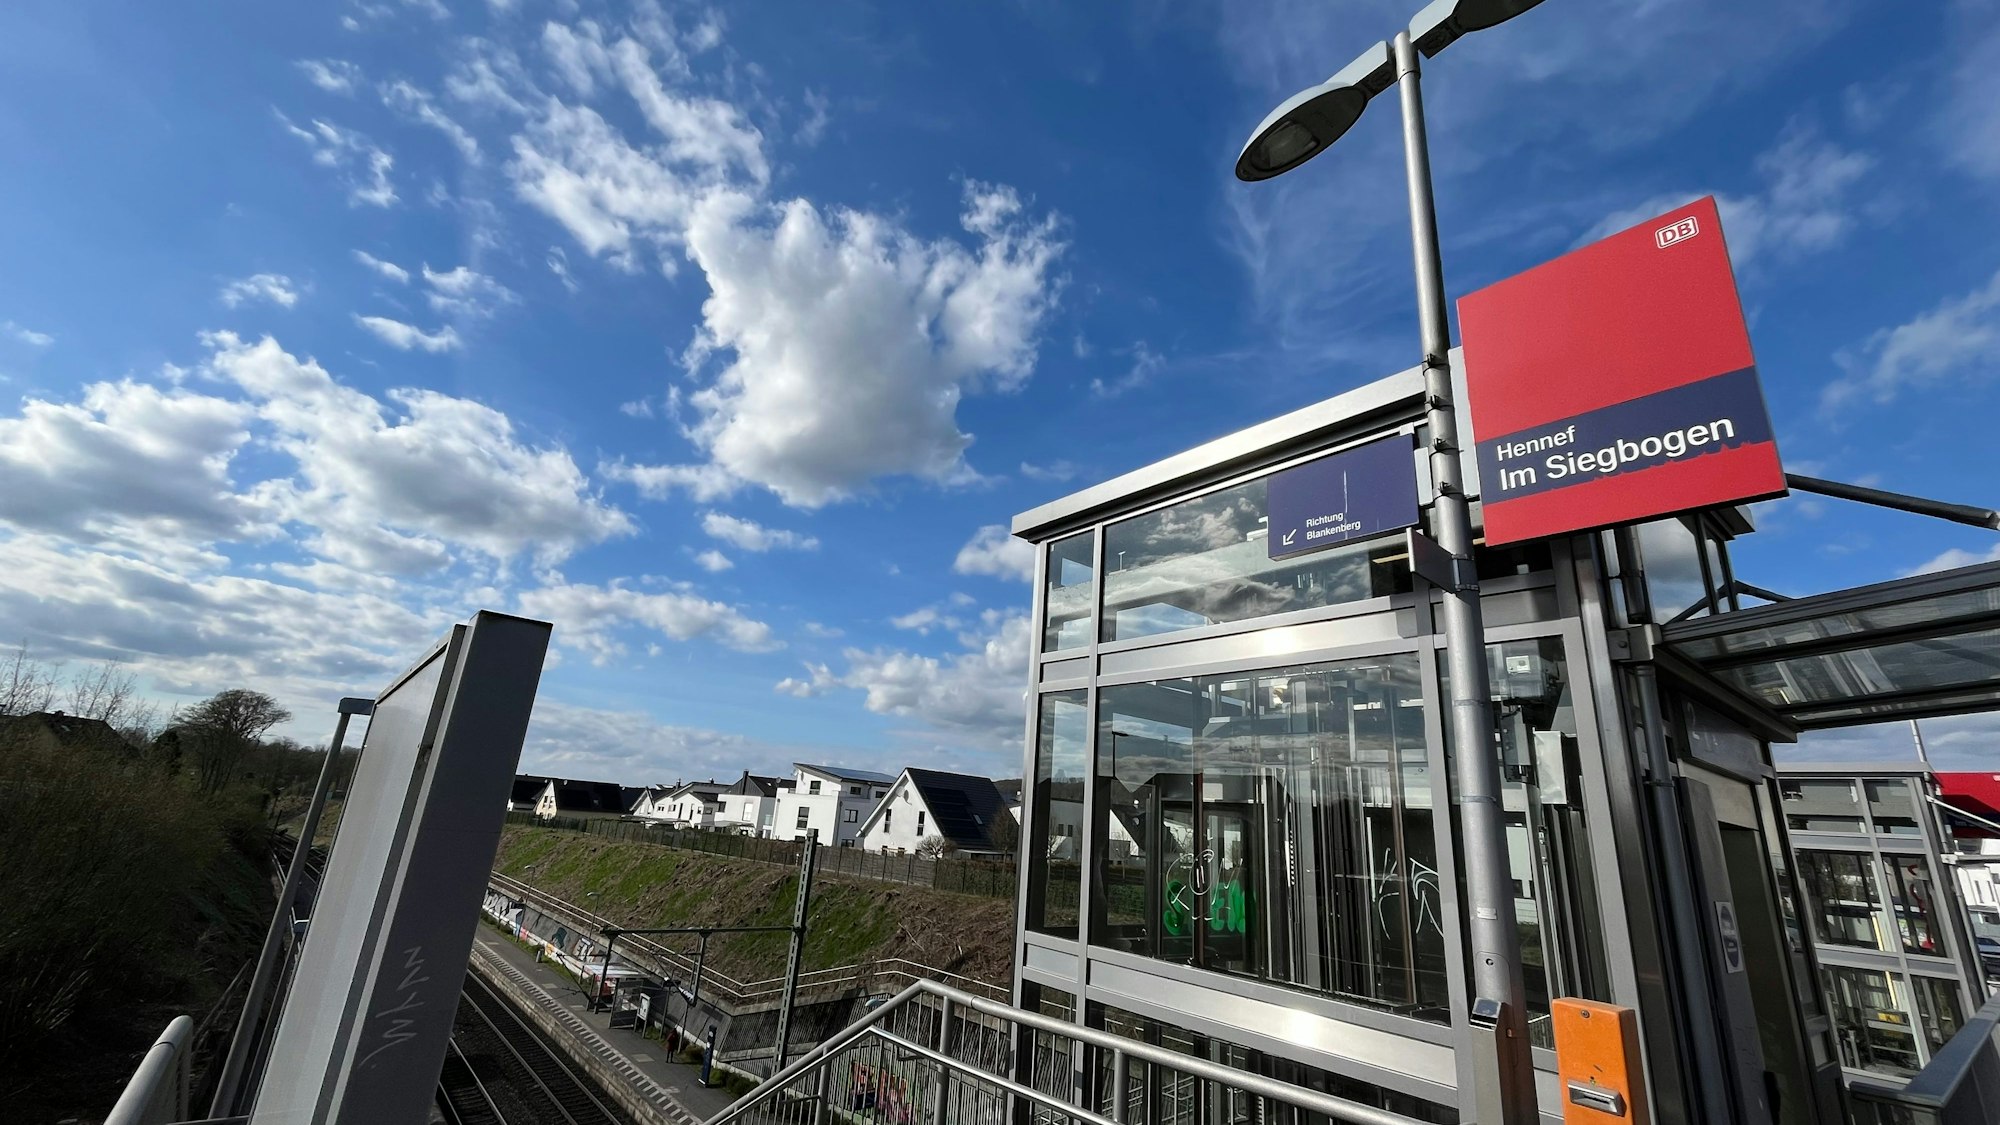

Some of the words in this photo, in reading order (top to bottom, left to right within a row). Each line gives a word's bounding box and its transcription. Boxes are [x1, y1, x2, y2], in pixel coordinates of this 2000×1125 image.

[1659, 220, 1695, 246] DB
[1496, 425, 1576, 461] Hennef
[1500, 467, 1536, 490] Im
[1546, 418, 1735, 479] Siegbogen
[1306, 512, 1344, 528] Richtung
[1306, 520, 1361, 541] Blankenberg
